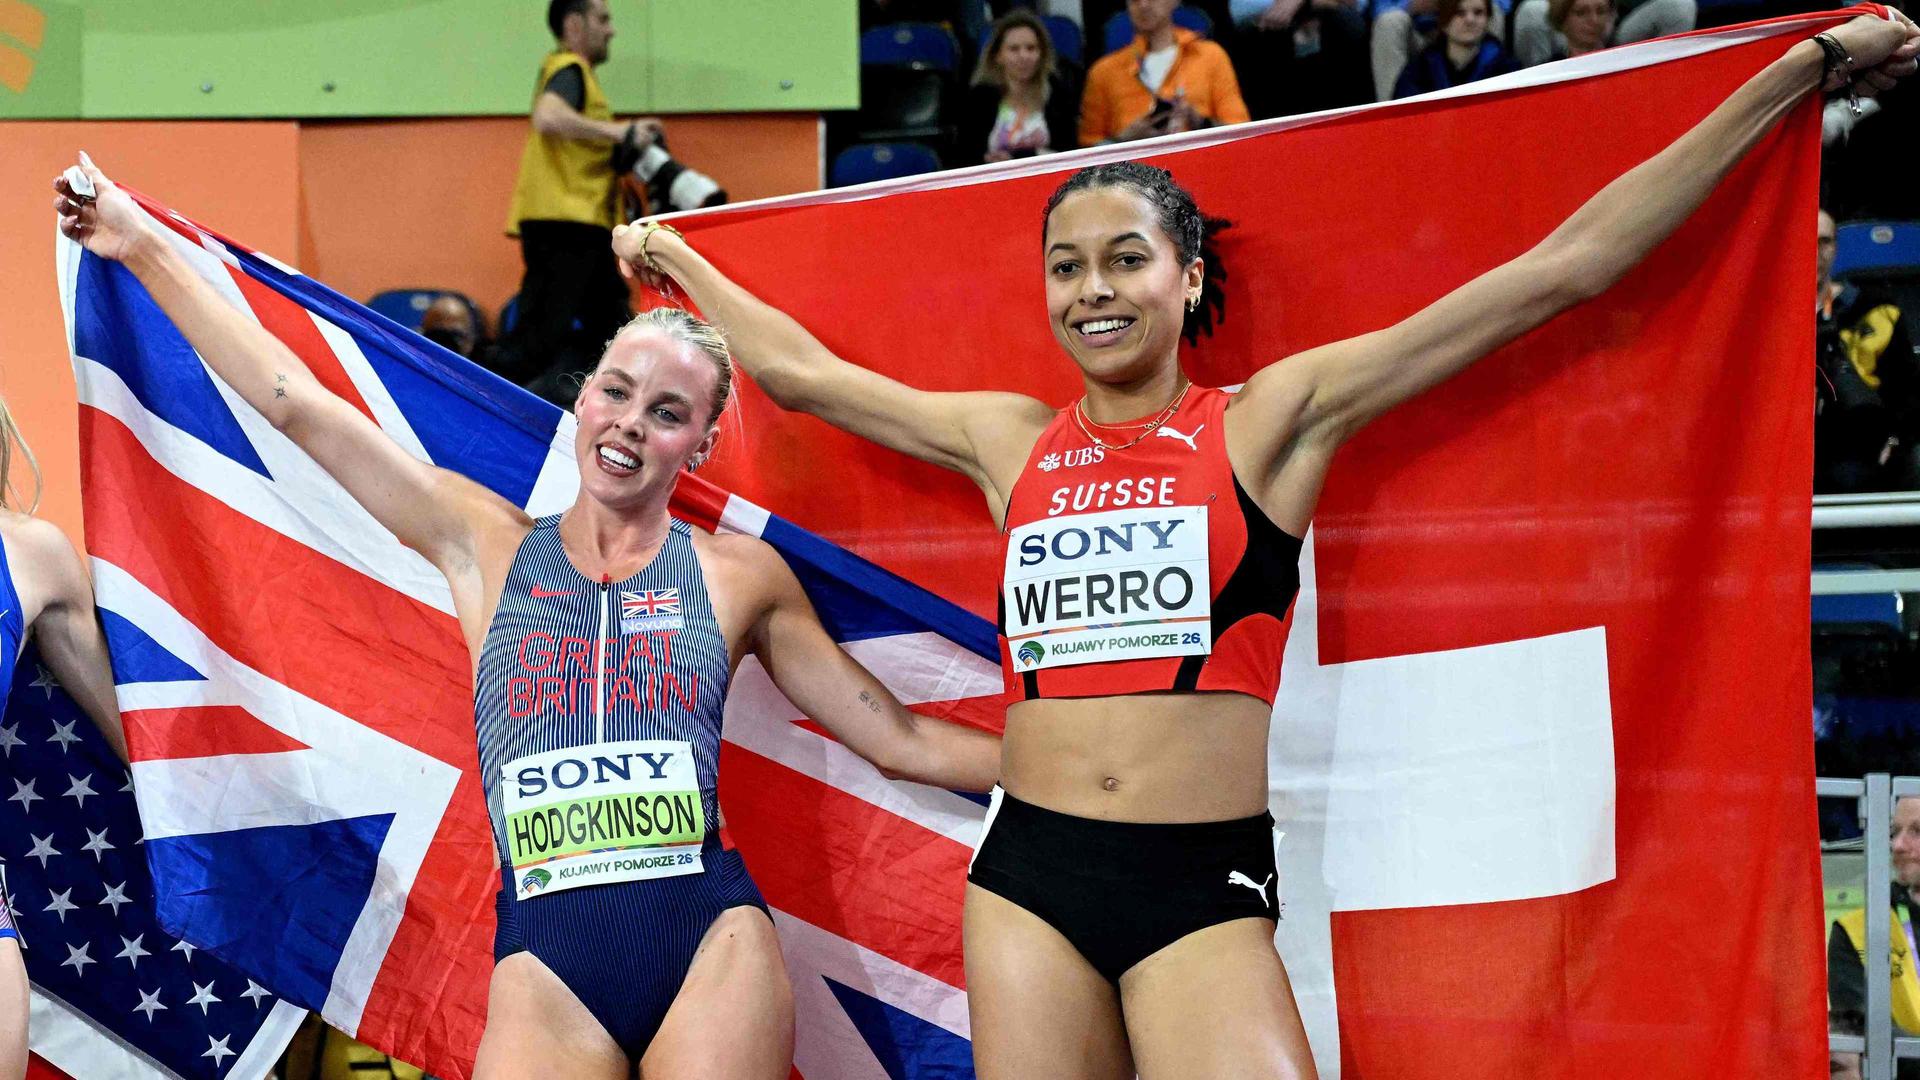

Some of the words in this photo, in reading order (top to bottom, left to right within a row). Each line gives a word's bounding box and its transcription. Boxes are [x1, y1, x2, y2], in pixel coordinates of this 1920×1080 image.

[1064, 445, 1106, 467] UBS
[1019, 519, 1185, 567] SONY
[1013, 566, 1193, 627] WERRO
[518, 630, 681, 674] GREAT
[1051, 639, 1105, 656] KUJAWY
[1108, 633, 1178, 650] POMORZE
[1181, 632, 1201, 645] 26
[508, 671, 699, 718] BRITAIN
[517, 752, 674, 799] SONY
[513, 794, 696, 858] HODGKINSON
[559, 861, 611, 880] KUJAWY
[614, 855, 675, 872] POMORZE
[677, 853, 694, 865] 26
